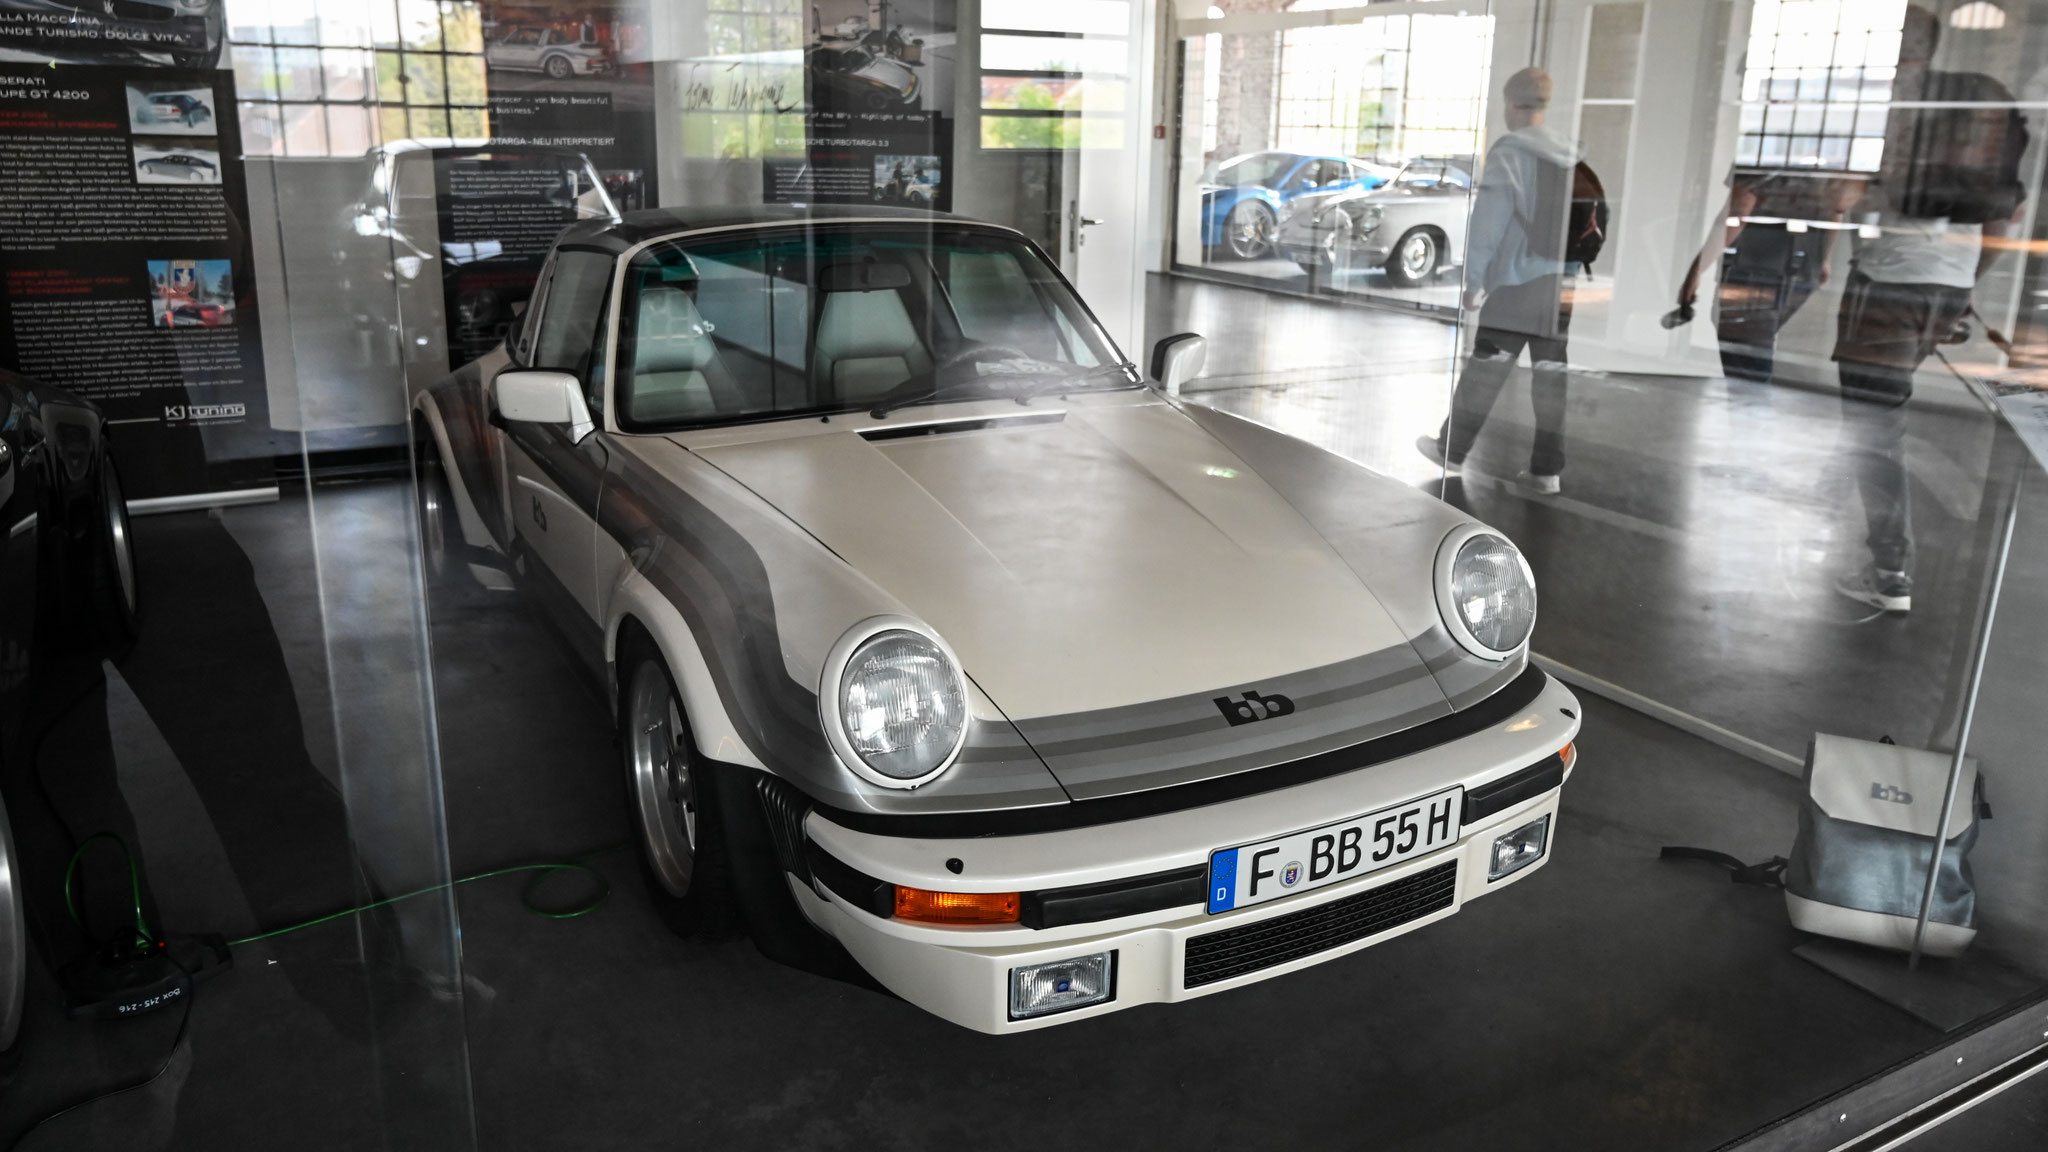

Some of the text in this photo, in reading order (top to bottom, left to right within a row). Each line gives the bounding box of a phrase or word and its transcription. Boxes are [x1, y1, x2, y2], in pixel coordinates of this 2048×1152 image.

[30, 89, 50, 99] GT
[52, 89, 90, 100] 4200
[1217, 887, 1227, 901] D
[1250, 847, 1280, 897] F
[1309, 826, 1363, 882] BB
